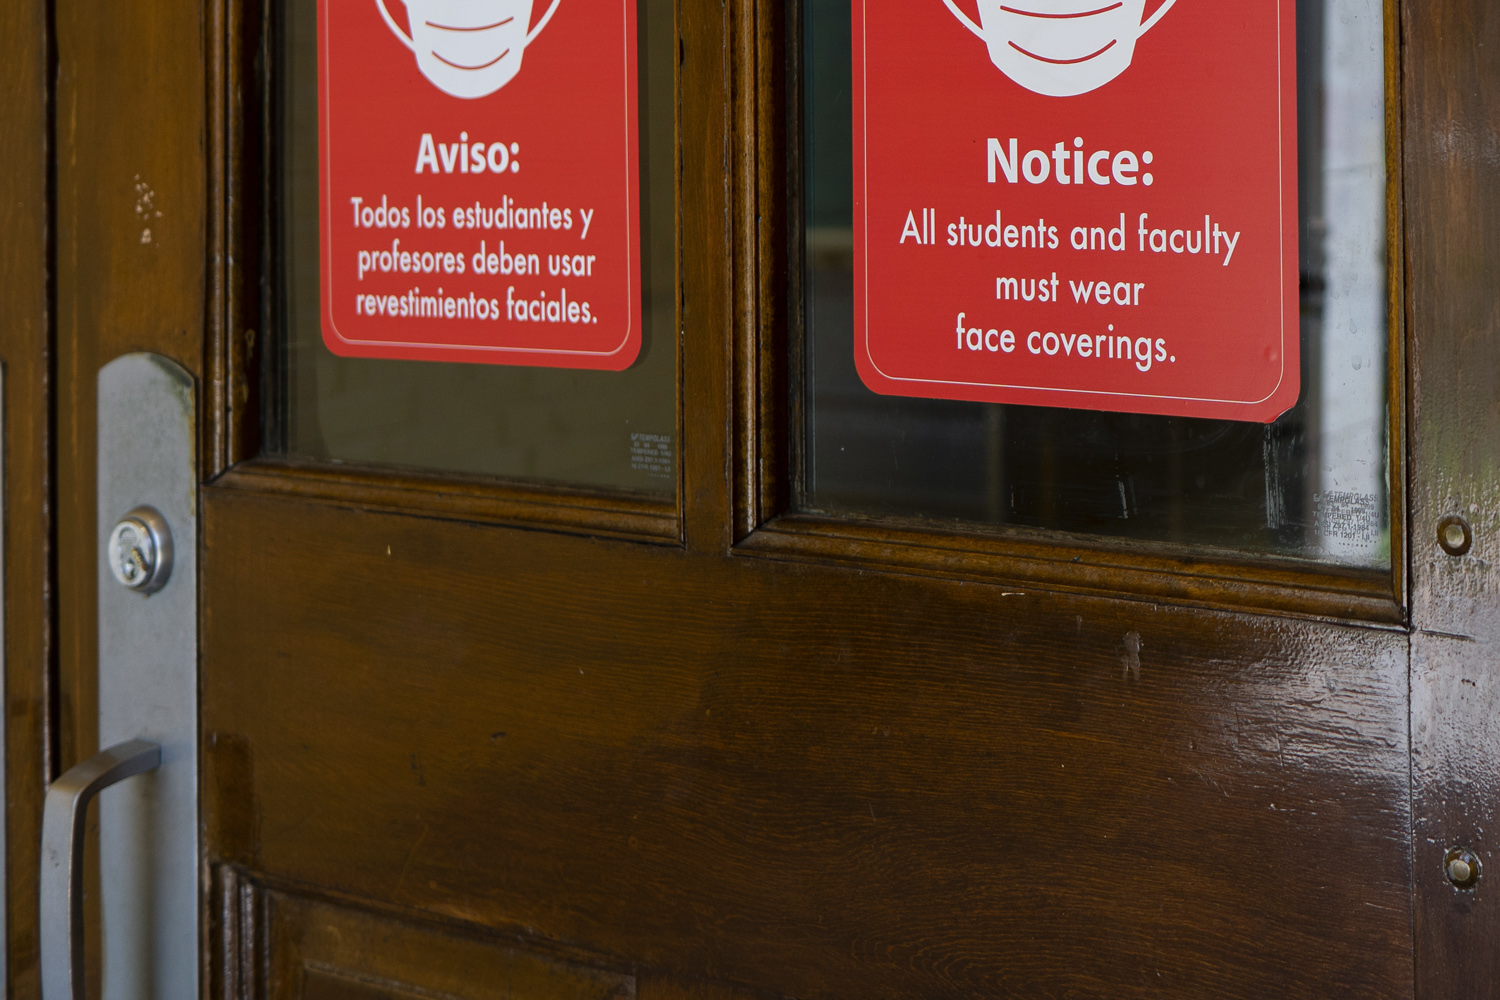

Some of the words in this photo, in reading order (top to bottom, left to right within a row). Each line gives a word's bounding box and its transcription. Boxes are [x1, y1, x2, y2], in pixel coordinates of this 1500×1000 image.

[415, 131, 520, 174] Aviso:
[987, 136, 1154, 186] Notice:
[351, 194, 411, 229] Todos
[417, 194, 446, 229] los
[452, 194, 573, 230] estudiantes
[580, 208, 594, 240] y
[899, 208, 936, 245] All
[947, 209, 1060, 250] students
[1070, 212, 1126, 251] and
[1138, 212, 1241, 266] faculty
[358, 238, 466, 280] profesores
[472, 240, 540, 275] deben
[548, 254, 596, 276] usar
[356, 286, 500, 320] revestimientos
[506, 285, 598, 324] faciales.
[996, 272, 1060, 302] must
[1069, 279, 1145, 306] wear
[956, 312, 1016, 353] face
[1027, 323, 1176, 372] coverings.
